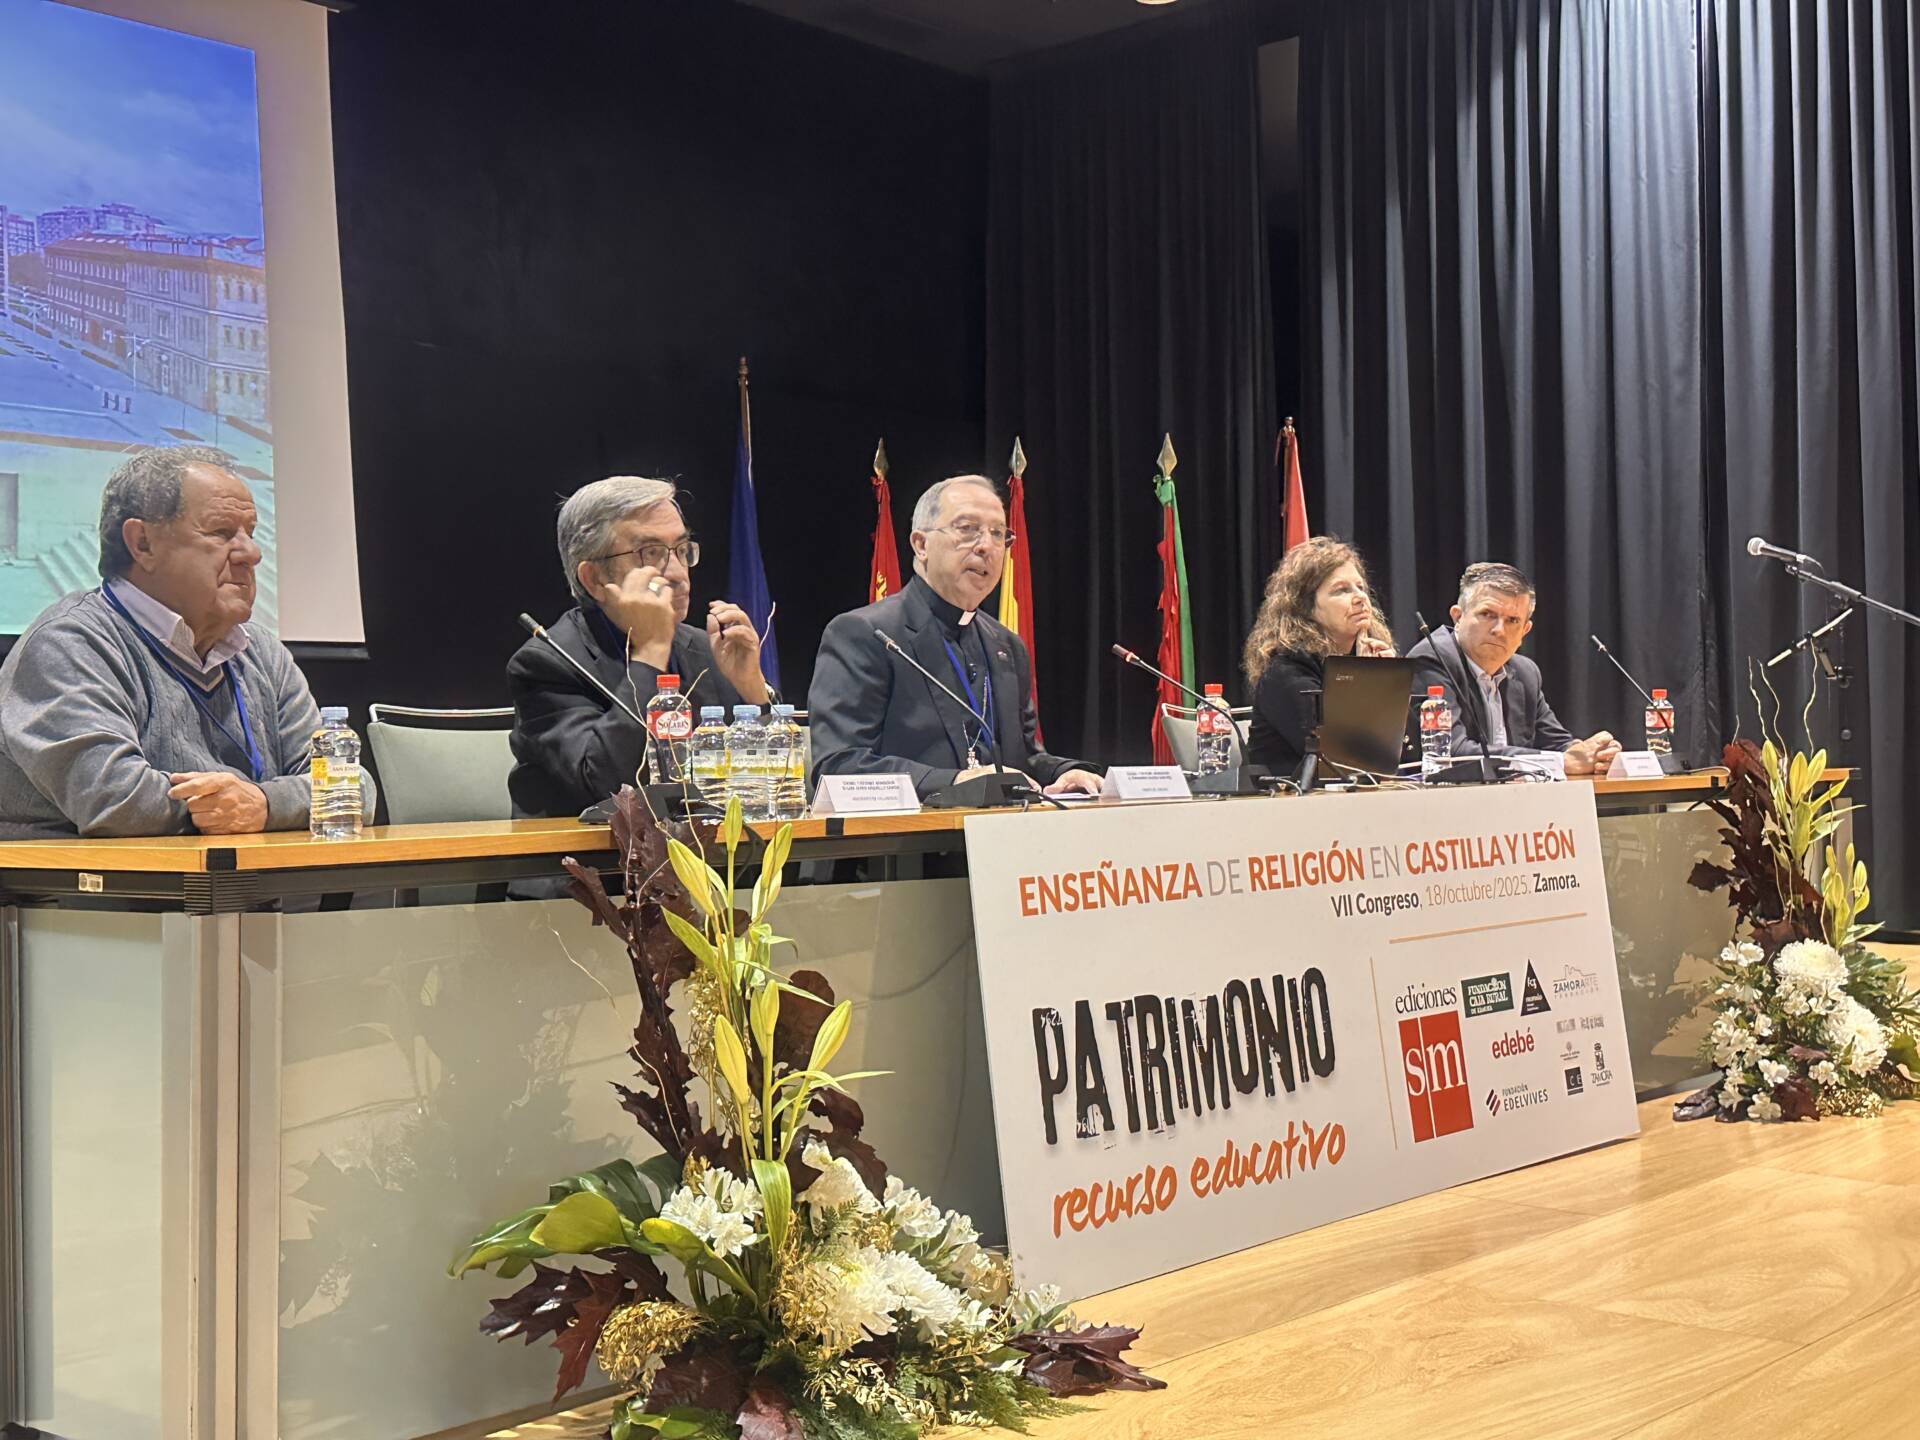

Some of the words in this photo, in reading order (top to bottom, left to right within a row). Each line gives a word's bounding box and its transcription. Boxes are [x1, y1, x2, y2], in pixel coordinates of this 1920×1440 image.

[1018, 860, 1203, 917] ENSEÑANZA
[1206, 858, 1244, 897] DE
[1247, 840, 1365, 892] RELIGIÓN
[1369, 844, 1401, 879] EN
[1405, 835, 1505, 875] CASTILLA
[1504, 833, 1519, 865] Y
[1522, 822, 1576, 863] LEÓN
[1331, 894, 1353, 918] VII
[1356, 891, 1423, 916] Congreso,
[1425, 874, 1532, 907] 18/octubre/2025.
[1533, 873, 1581, 893] Zamora.
[1395, 982, 1458, 1014] ediciones
[1032, 967, 1336, 1146] PATRIMONIO
[1405, 1039, 1466, 1096] sm
[1492, 1026, 1535, 1059] edebé
[1503, 1088, 1549, 1112] EDELVIVES
[1053, 1164, 1178, 1238] recurso
[1190, 1119, 1346, 1199] educativo
